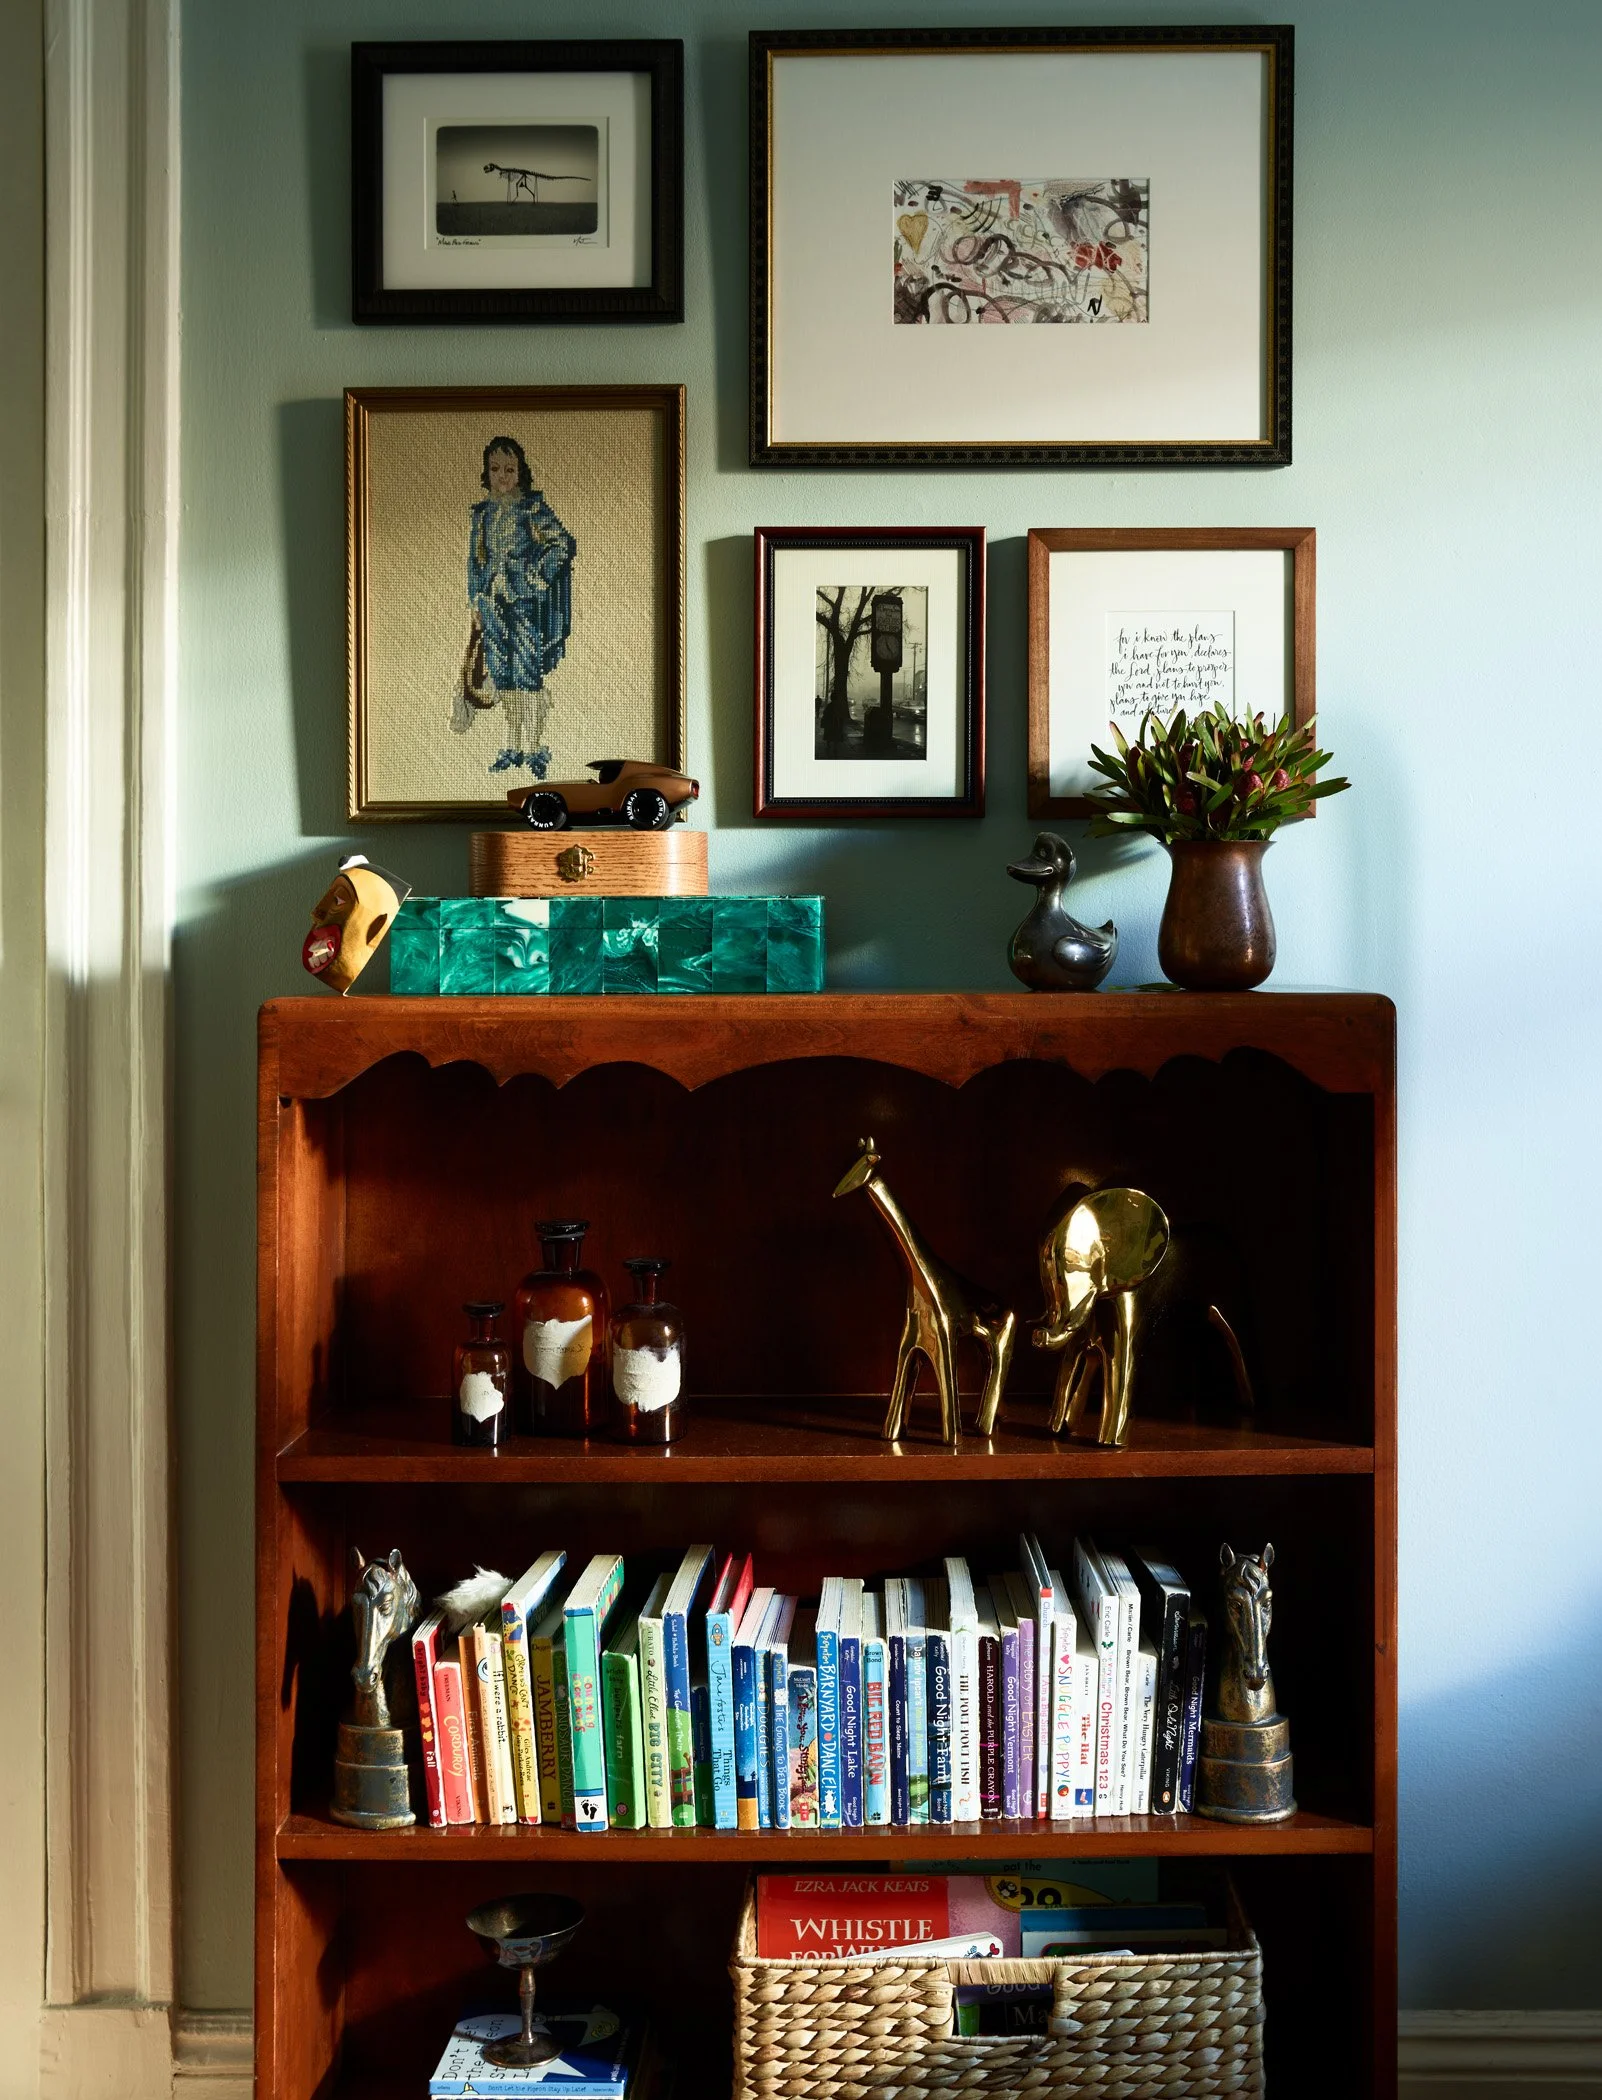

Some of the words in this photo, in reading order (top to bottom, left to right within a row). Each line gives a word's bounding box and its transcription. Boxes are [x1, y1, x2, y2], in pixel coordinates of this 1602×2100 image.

[1113, 628, 1130, 654] for
[1142, 627, 1167, 644] know
[1170, 628, 1186, 643] the
[1187, 624, 1222, 649] plans
[1130, 645, 1155, 660] have
[1154, 645, 1168, 667] for
[1194, 643, 1231, 659] declares
[1108, 662, 1126, 679] the
[1156, 661, 1187, 682] plans
[1186, 662, 1196, 672] to
[1196, 662, 1232, 681] prosper
[1135, 677, 1152, 689] and
[1155, 678, 1170, 690] not
[1171, 677, 1181, 690] to
[1181, 675, 1204, 690] hurt
[1110, 692, 1140, 714] plans
[1139, 691, 1149, 704] to
[1150, 692, 1169, 709] give
[1186, 689, 1211, 708] hope
[1120, 703, 1137, 717] and
[626, 792, 638, 821] SUNRAY
[651, 797, 664, 826] SUNRAY
[1042, 1601, 1051, 1628] Church
[1103, 1605, 1112, 1619] Eric
[646, 1626, 654, 1656] CURATO
[1103, 1619, 1112, 1638] Carle
[821, 1633, 833, 1664] Boynton
[1023, 1639, 1034, 1657] The
[443, 1674, 451, 1703] FREEMAN
[507, 1664, 519, 1696] DANCE
[645, 1670, 658, 1694] Little
[934, 1665, 947, 1701] Good
[959, 1673, 970, 1694] THE
[986, 1665, 995, 1703] HAROLD
[1007, 1676, 1017, 1701] Good
[1020, 1660, 1035, 1692] Story
[1041, 1680, 1050, 1693] Am
[1190, 1675, 1200, 1696] Good
[494, 1684, 502, 1705] were
[819, 1664, 836, 1730] BARNYARD
[846, 1685, 856, 1713] Good
[866, 1681, 883, 1708] BIG
[1023, 1696, 1034, 1707] of
[1058, 1666, 1072, 1730] SNUGGLE
[1143, 1695, 1152, 1708] The
[1188, 1696, 1199, 1719] Night
[647, 1696, 659, 1720] Elliot
[776, 1706, 785, 1722] THE
[986, 1704, 994, 1717] and
[1006, 1703, 1017, 1733] Night
[1040, 1702, 1050, 1715] Big
[1141, 1709, 1151, 1723] Very
[467, 1711, 478, 1734] First
[536, 1675, 557, 1781] JAMBERRY
[556, 1701, 571, 1762] DINOSAUR
[648, 1722, 662, 1748] BIG
[844, 1716, 857, 1748] Night
[867, 1710, 883, 1739] RED
[894, 1724, 902, 1740] Sleep
[933, 1703, 948, 1742] Night
[959, 1697, 971, 1758] POUT-POUT
[986, 1719, 994, 1729] the
[1081, 1713, 1091, 1741] The
[1099, 1701, 1113, 1765] Christmas
[1140, 1723, 1150, 1748] Hungry
[758, 1705, 770, 1768] DOGGIES
[775, 1725, 786, 1751] GOING
[987, 1730, 995, 1764] PURPLE
[1021, 1711, 1035, 1762] EASTER
[1121, 1740, 1128, 1749] Do
[1163, 1722, 1179, 1751] Night
[1185, 1721, 1197, 1765] Mermaids
[470, 1738, 482, 1781] Animals
[712, 1748, 723, 1773] That
[776, 1753, 785, 1765] TO
[821, 1740, 837, 1789] DANCE!
[847, 1750, 858, 1778] Lake
[936, 1749, 949, 1784] Farm
[1006, 1735, 1016, 1774] Vermont
[1055, 1735, 1072, 1783] PUPPY!
[1080, 1742, 1090, 1765] Hat
[1138, 1748, 1148, 1780] Caterpillar
[650, 1752, 663, 1788] CITY
[722, 1749, 733, 1786] Things
[777, 1766, 787, 1785] BED
[960, 1761, 971, 1785] FISH
[1119, 1762, 1127, 1778] See?
[713, 1776, 722, 1792] Go
[987, 1766, 996, 1803] CRAYON
[777, 1787, 787, 1811] BOOK
[1025, 1860, 1042, 1872] the
[793, 1880, 836, 1893] EZRA
[838, 1880, 880, 1893] JACK
[883, 1880, 930, 1893] KEATS
[789, 1918, 934, 1941] WHISTLE
[442, 2048, 469, 2080] Don't
[458, 2025, 480, 2043] Let
[465, 2060, 486, 2080] the
